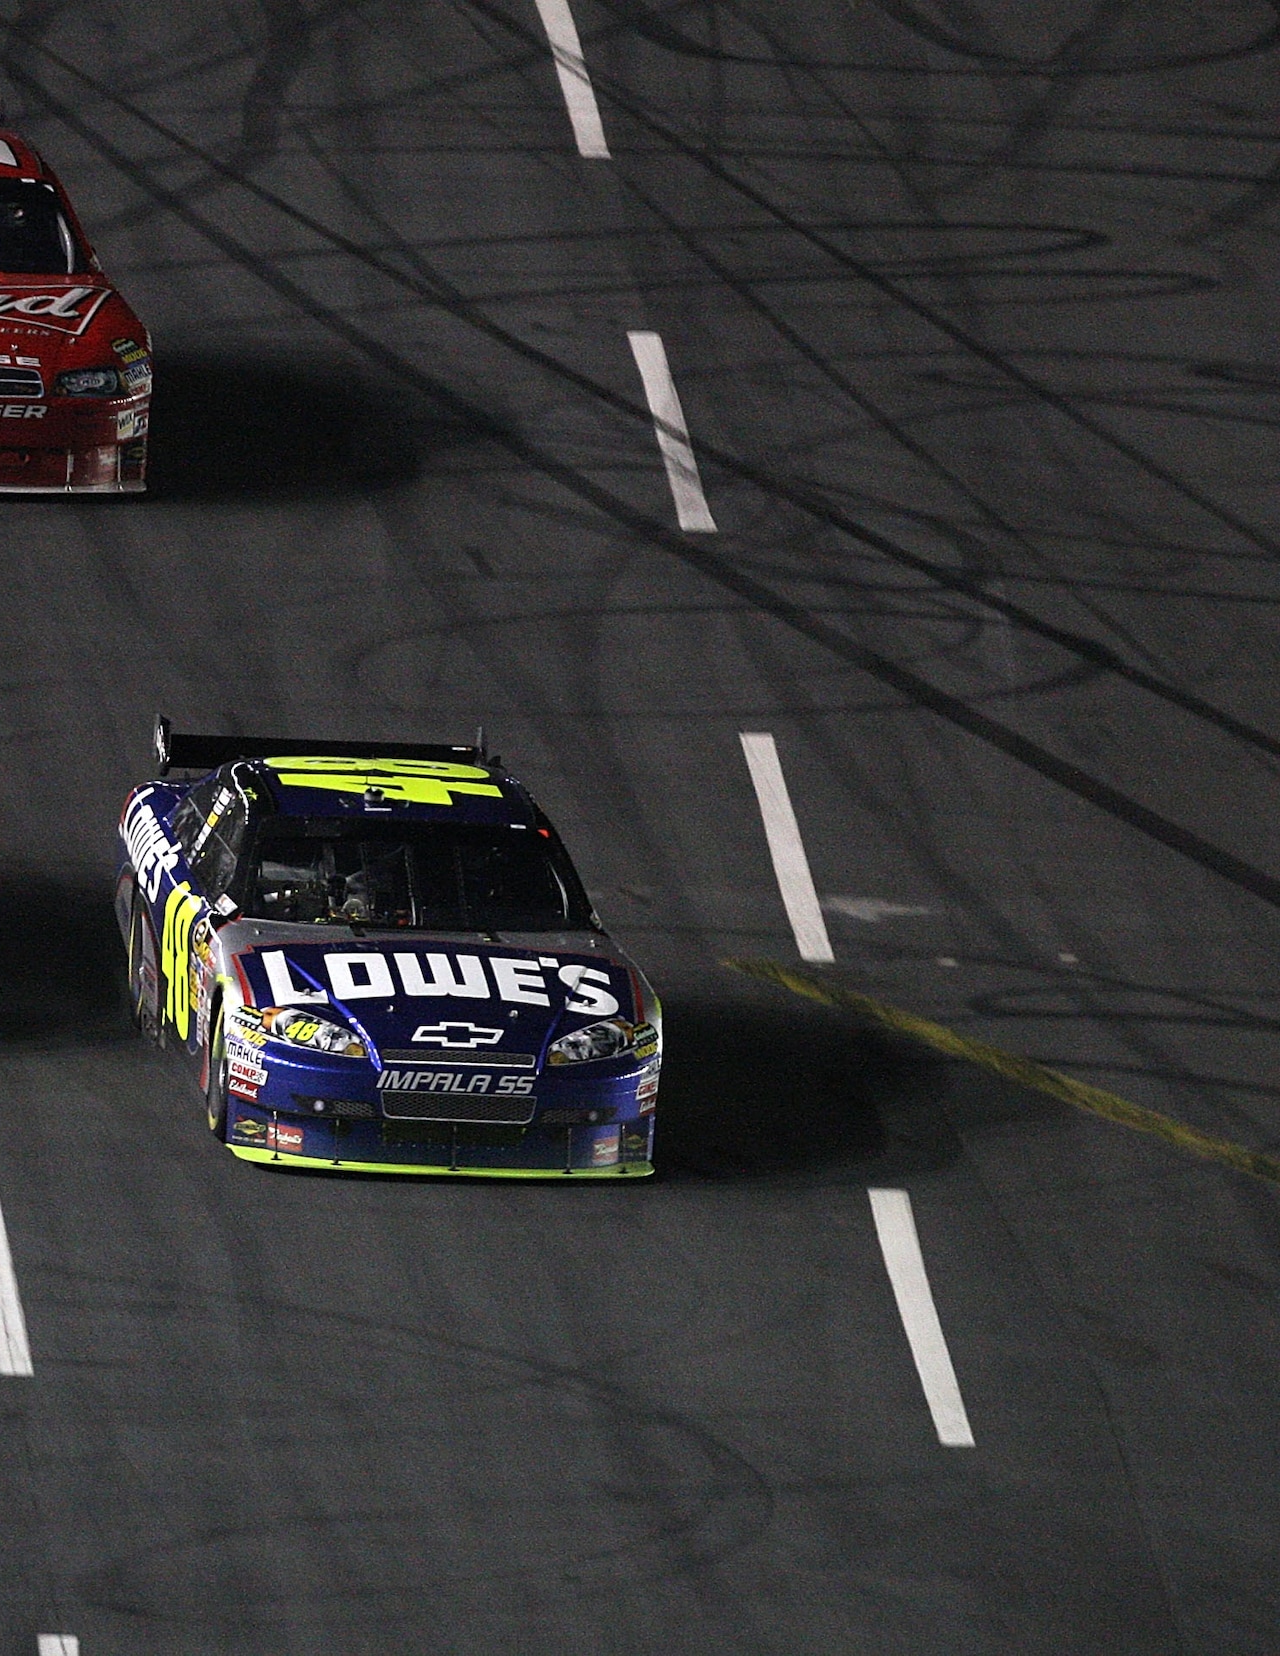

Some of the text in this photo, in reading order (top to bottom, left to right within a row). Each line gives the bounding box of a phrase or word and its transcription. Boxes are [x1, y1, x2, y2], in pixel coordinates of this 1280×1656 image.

[263, 755, 504, 806] 48
[161, 880, 202, 1041] 48
[261, 950, 620, 1016] LOWE'S
[284, 1020, 321, 1042] 48
[227, 1041, 263, 1065] MAHLE
[231, 1061, 257, 1079] COMP
[375, 1070, 537, 1094] IMPALA SS
